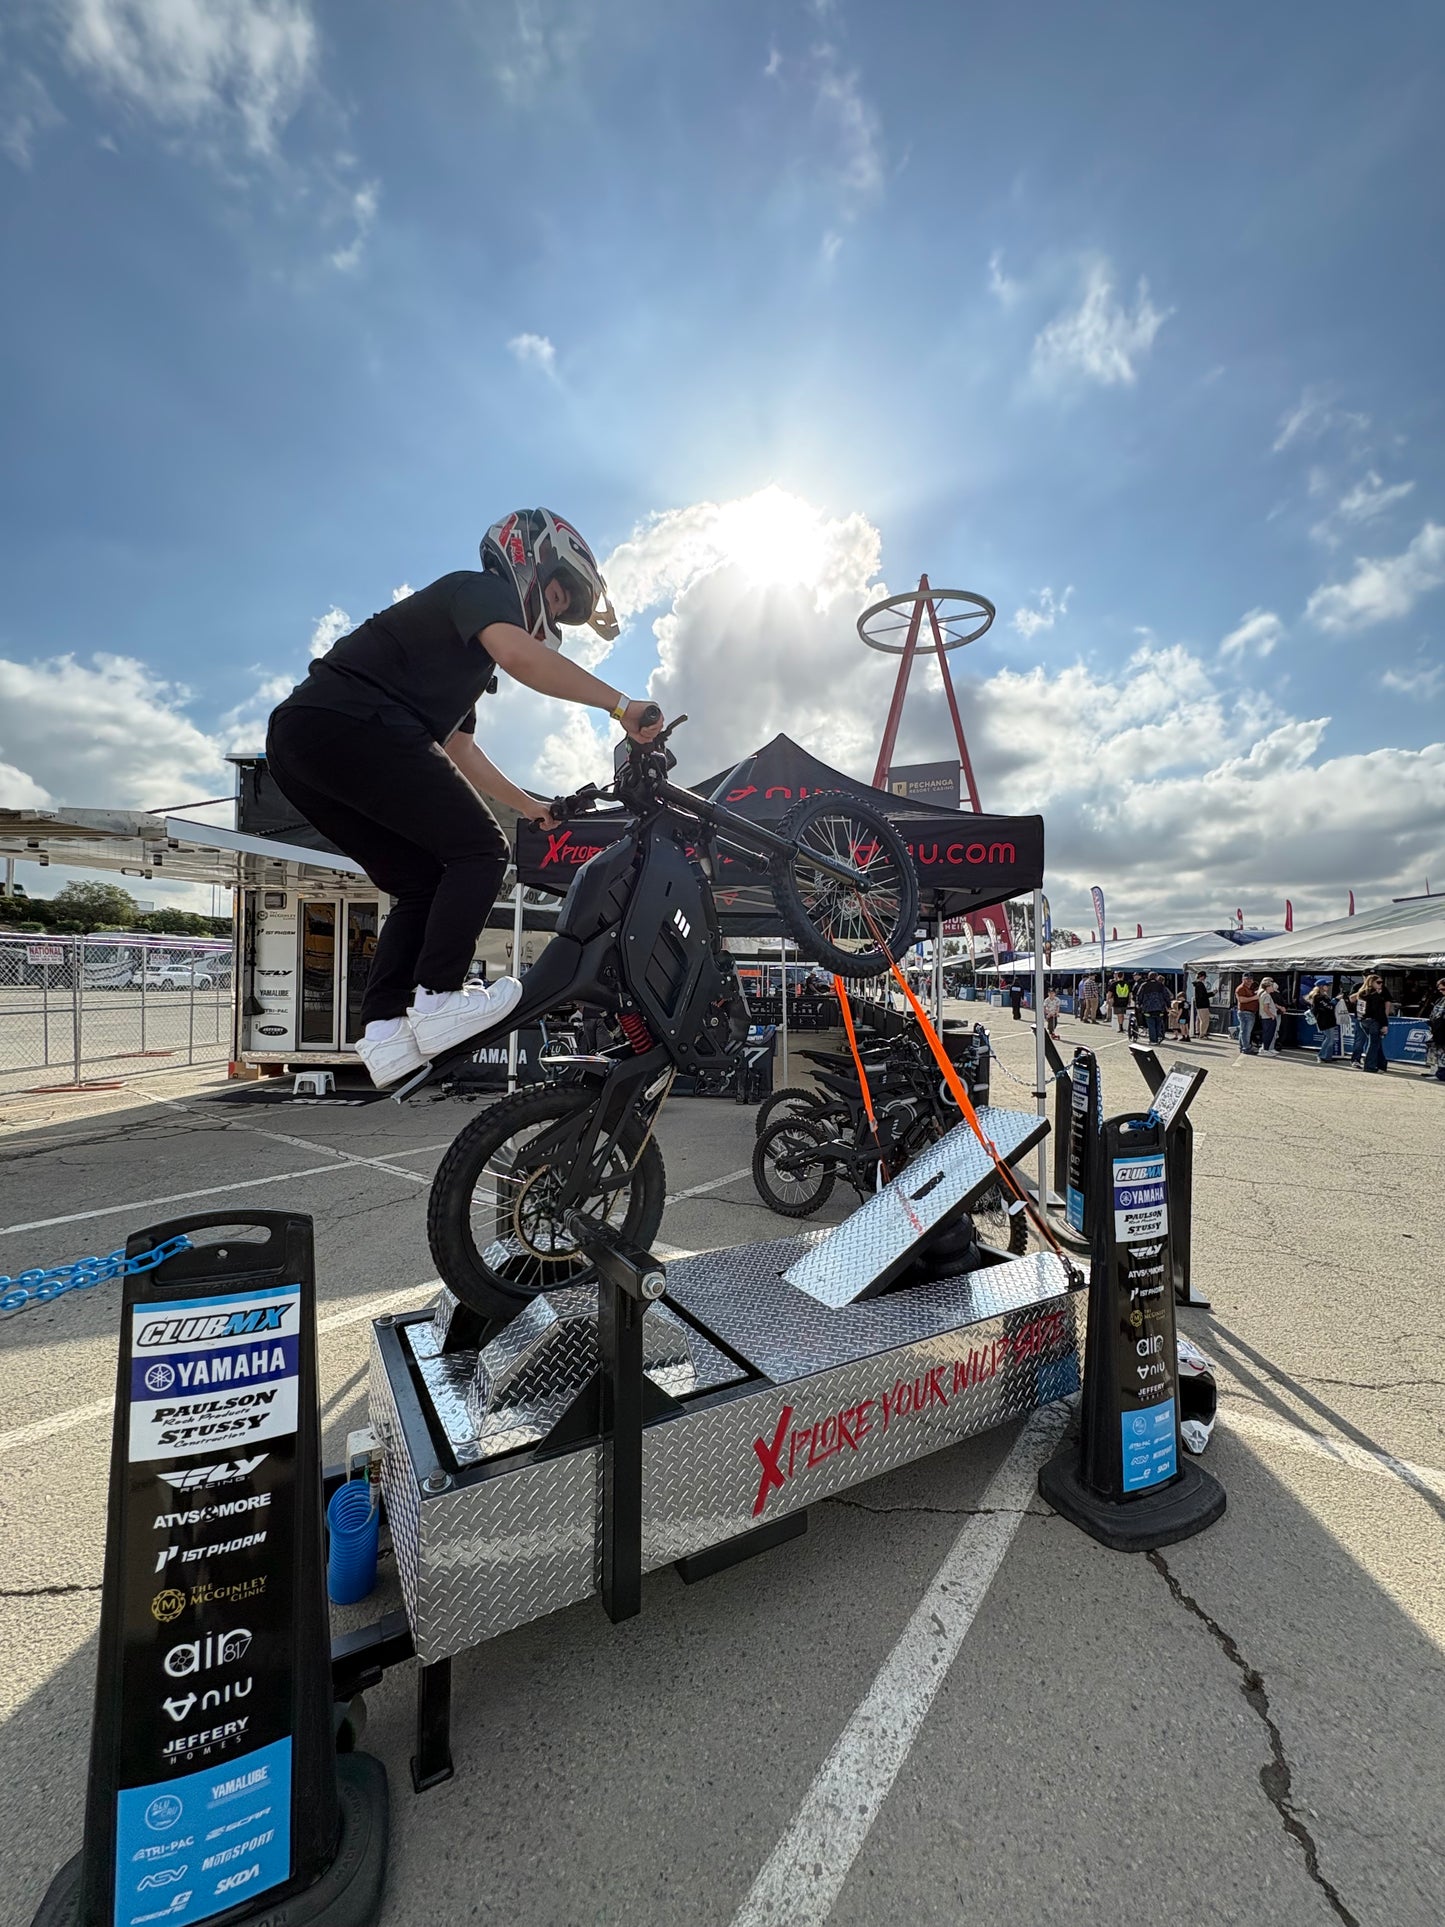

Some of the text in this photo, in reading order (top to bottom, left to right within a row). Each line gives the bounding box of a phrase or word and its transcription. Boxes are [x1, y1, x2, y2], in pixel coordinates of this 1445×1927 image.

[909, 779, 954, 789] PECHANGA
[539, 830, 606, 869] XPLOR
[29, 947, 62, 955] NATIONAL
[472, 1048, 527, 1064] YAMAA
[1116, 1164, 1163, 1182] CLUBMX
[1132, 1187, 1164, 1204] YAMAHA
[1124, 1210, 1162, 1222] PAULSON
[1128, 1222, 1161, 1234] STUSSY
[1128, 1243, 1163, 1257] FLY
[137, 1302, 296, 1347] CLUBMX
[1137, 1333, 1164, 1356] air
[178, 1347, 286, 1387] YAMAHA
[1138, 1382, 1164, 1395] JEFFERY
[151, 1389, 278, 1423] PAULSON
[163, 1408, 250, 1426] Rock Products
[752, 1309, 1067, 1519] XPLORE YOUR WILD SIDE
[158, 1412, 270, 1445] STUSSY
[173, 1432, 246, 1448] Construction
[156, 1453, 270, 1488] FLY
[180, 1476, 246, 1493] RACING
[153, 1492, 271, 1530] ATVS&MORE
[190, 1582, 213, 1594] THE
[190, 1575, 267, 1606] MCGINLEY
[230, 1586, 266, 1601] CLINIC
[164, 1628, 253, 1677] air
[223, 1637, 253, 1662] 817
[163, 1716, 249, 1753] JEFFERY
[170, 1735, 242, 1765] HOMES
[212, 1765, 270, 1800] YAMALUBE
[145, 1836, 194, 1858] TRI-PAC
